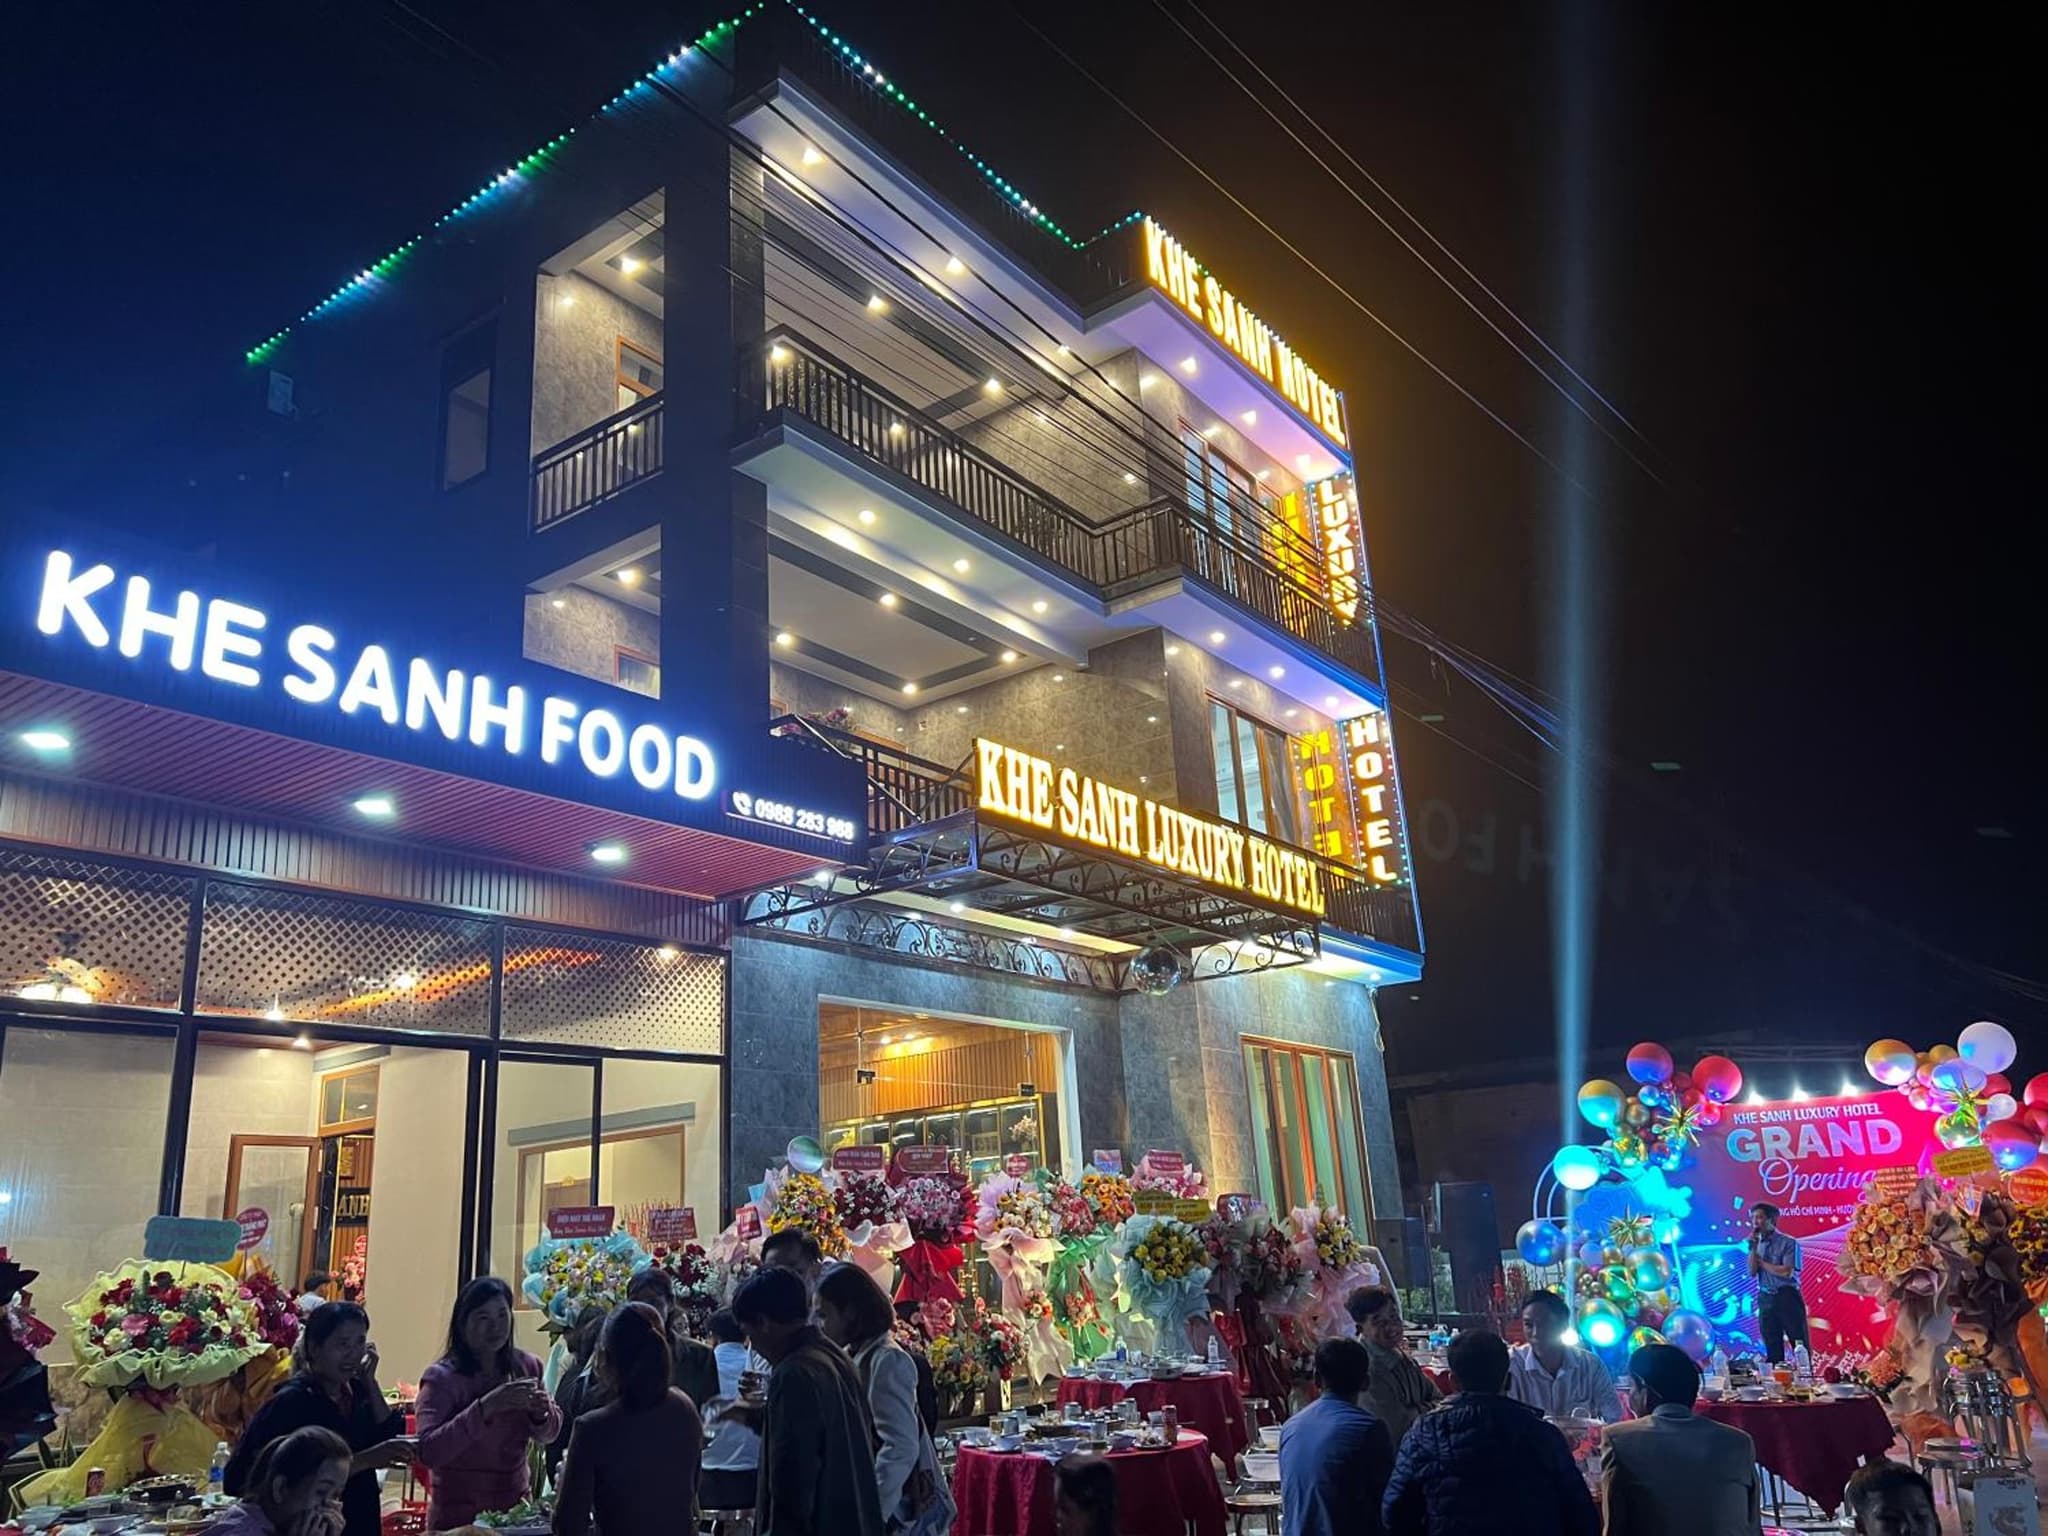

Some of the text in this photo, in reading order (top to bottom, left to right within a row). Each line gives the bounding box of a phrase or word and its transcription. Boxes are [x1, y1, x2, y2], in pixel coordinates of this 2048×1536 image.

[1144, 215, 1346, 446] KHE SANH HOTEL
[1318, 479, 1359, 626] LUXURY
[36, 549, 717, 800] KHE SANH FOOD
[977, 737, 1054, 829] KHE
[1059, 766, 1140, 857] SANH
[1144, 799, 1247, 890] LUXURY
[1248, 837, 1325, 915] HOTEL
[1350, 716, 1398, 882] HOTEL
[1726, 1118, 1902, 1162] GRAND
[1733, 1102, 1882, 1124] KHE SANH LUXURY HOTEL
